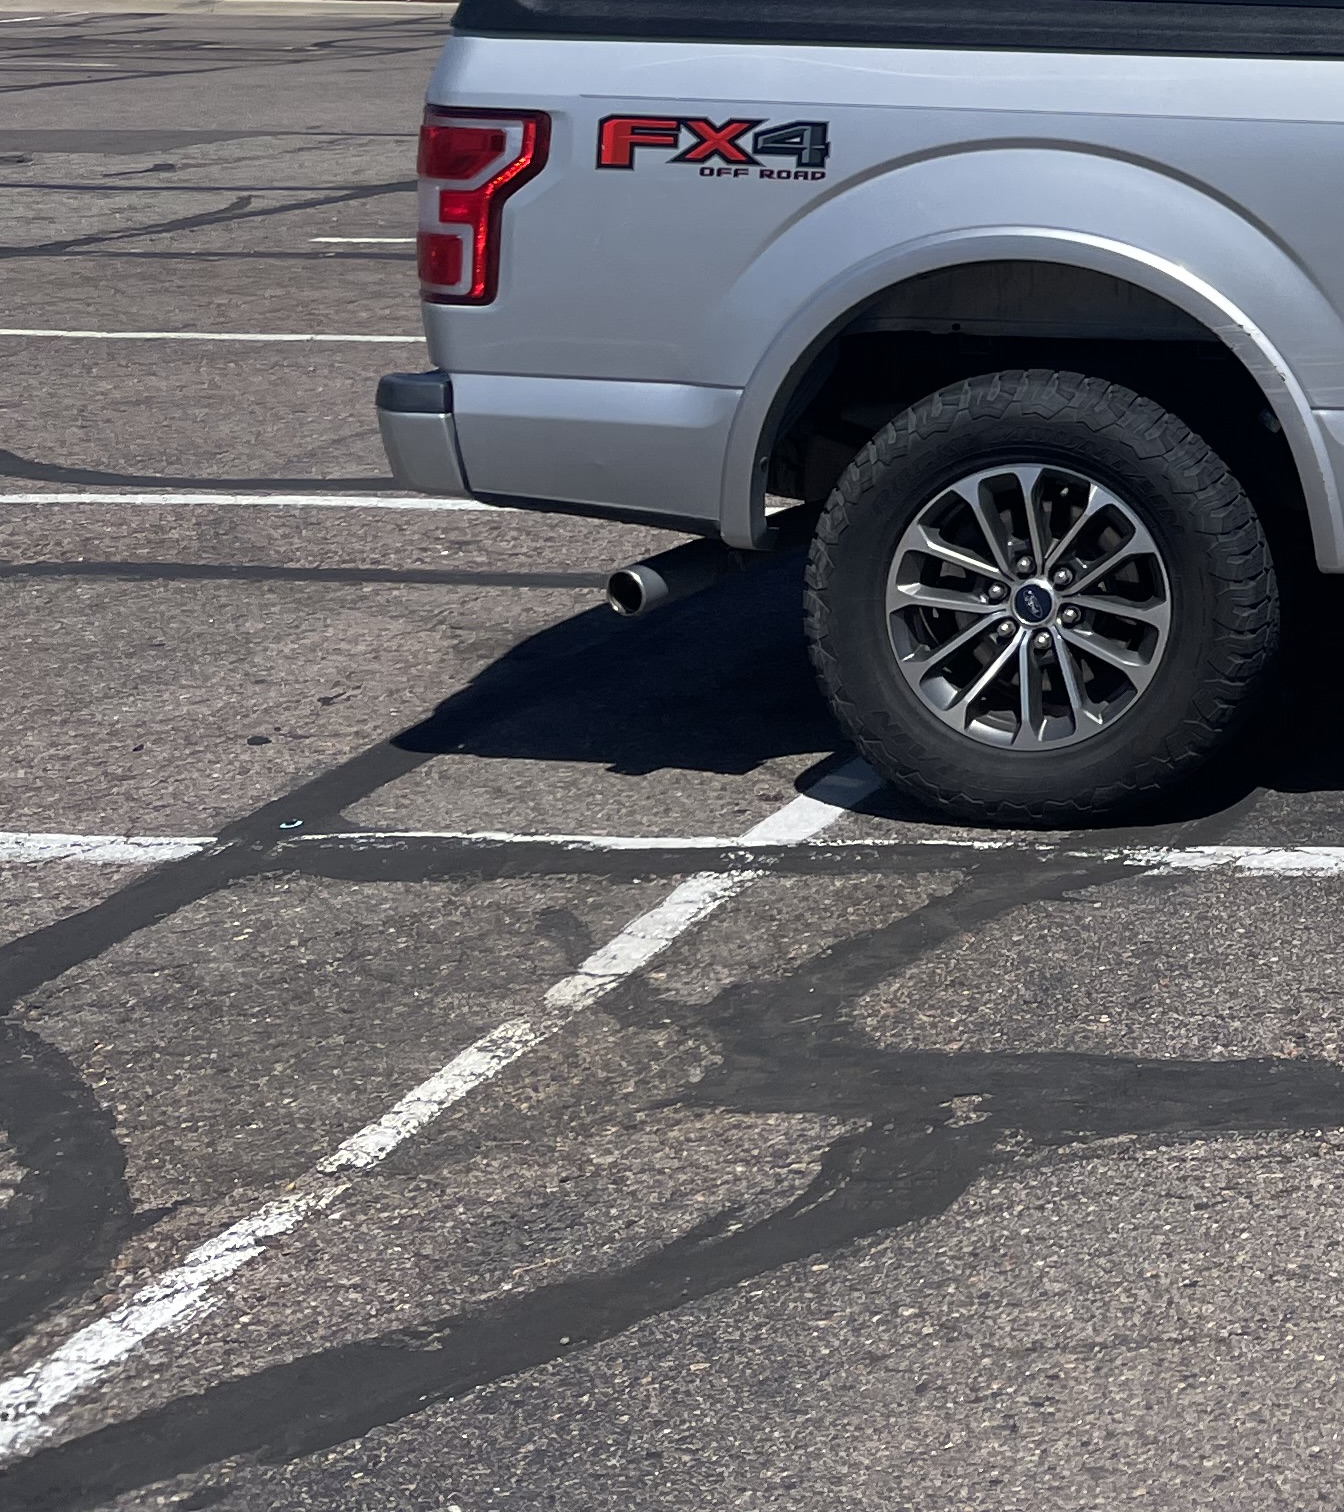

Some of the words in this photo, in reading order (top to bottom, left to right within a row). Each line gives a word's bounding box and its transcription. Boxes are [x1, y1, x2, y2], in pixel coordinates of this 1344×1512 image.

[595, 114, 831, 171] FX4
[700, 167, 750, 178] OFF
[759, 168, 826, 181] ROAD
